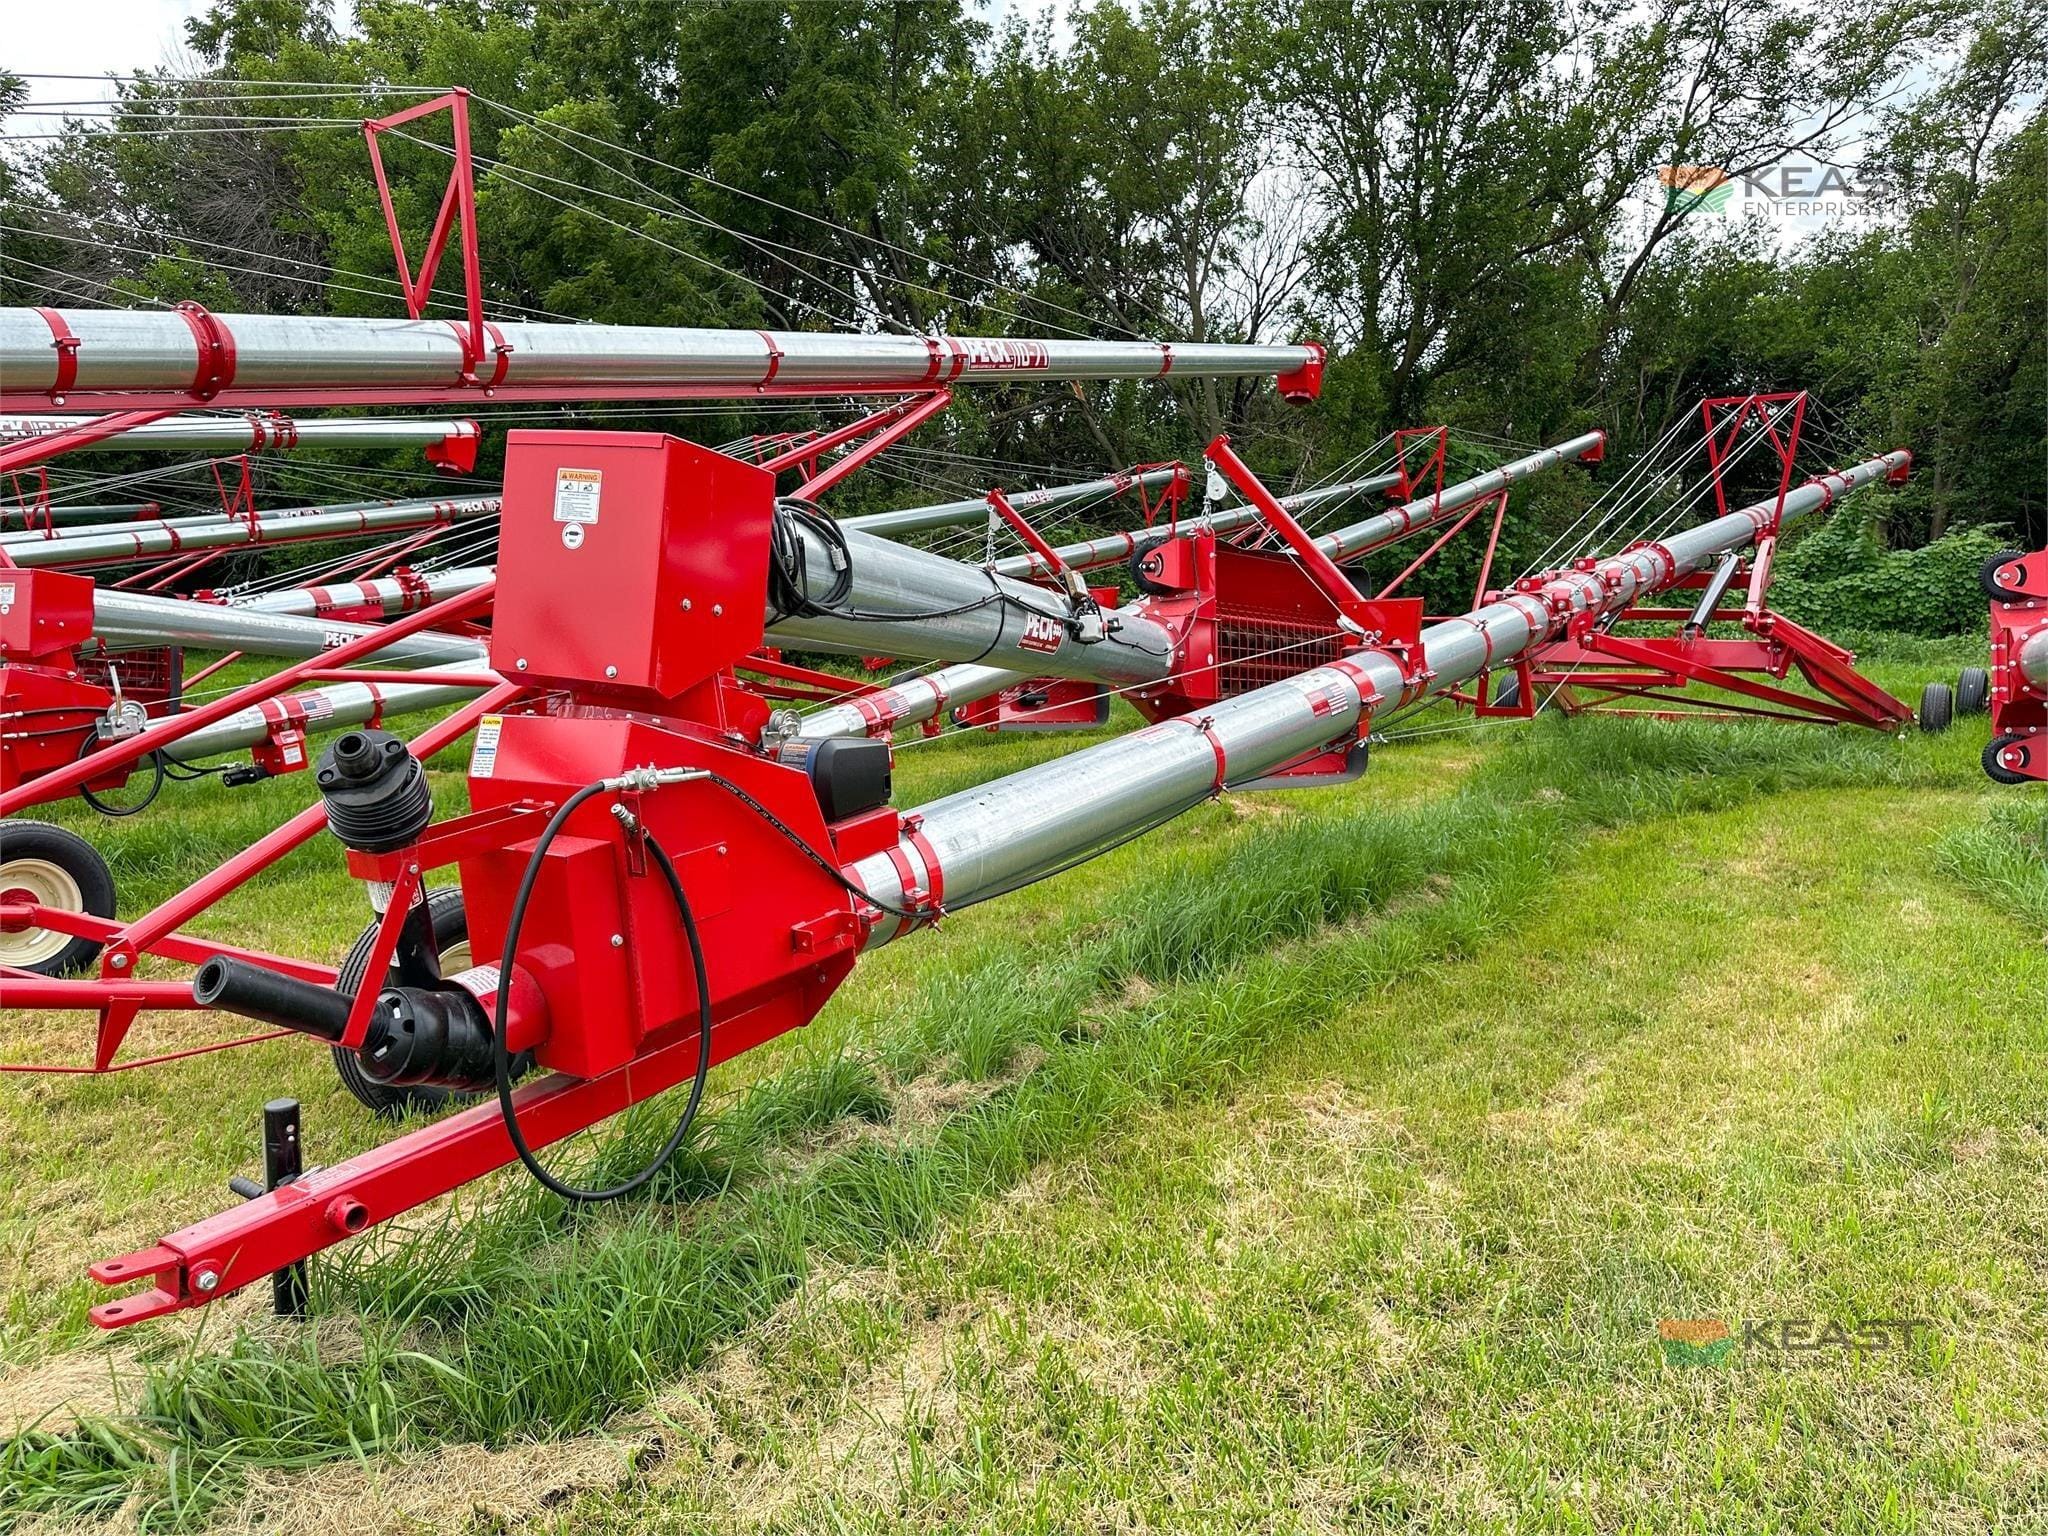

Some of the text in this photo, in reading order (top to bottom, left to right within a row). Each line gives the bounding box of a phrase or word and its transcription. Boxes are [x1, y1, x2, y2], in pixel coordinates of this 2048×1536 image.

[967, 341, 1012, 363] PECK
[569, 473, 598, 481] WARNING
[1024, 612, 1054, 641] PECK
